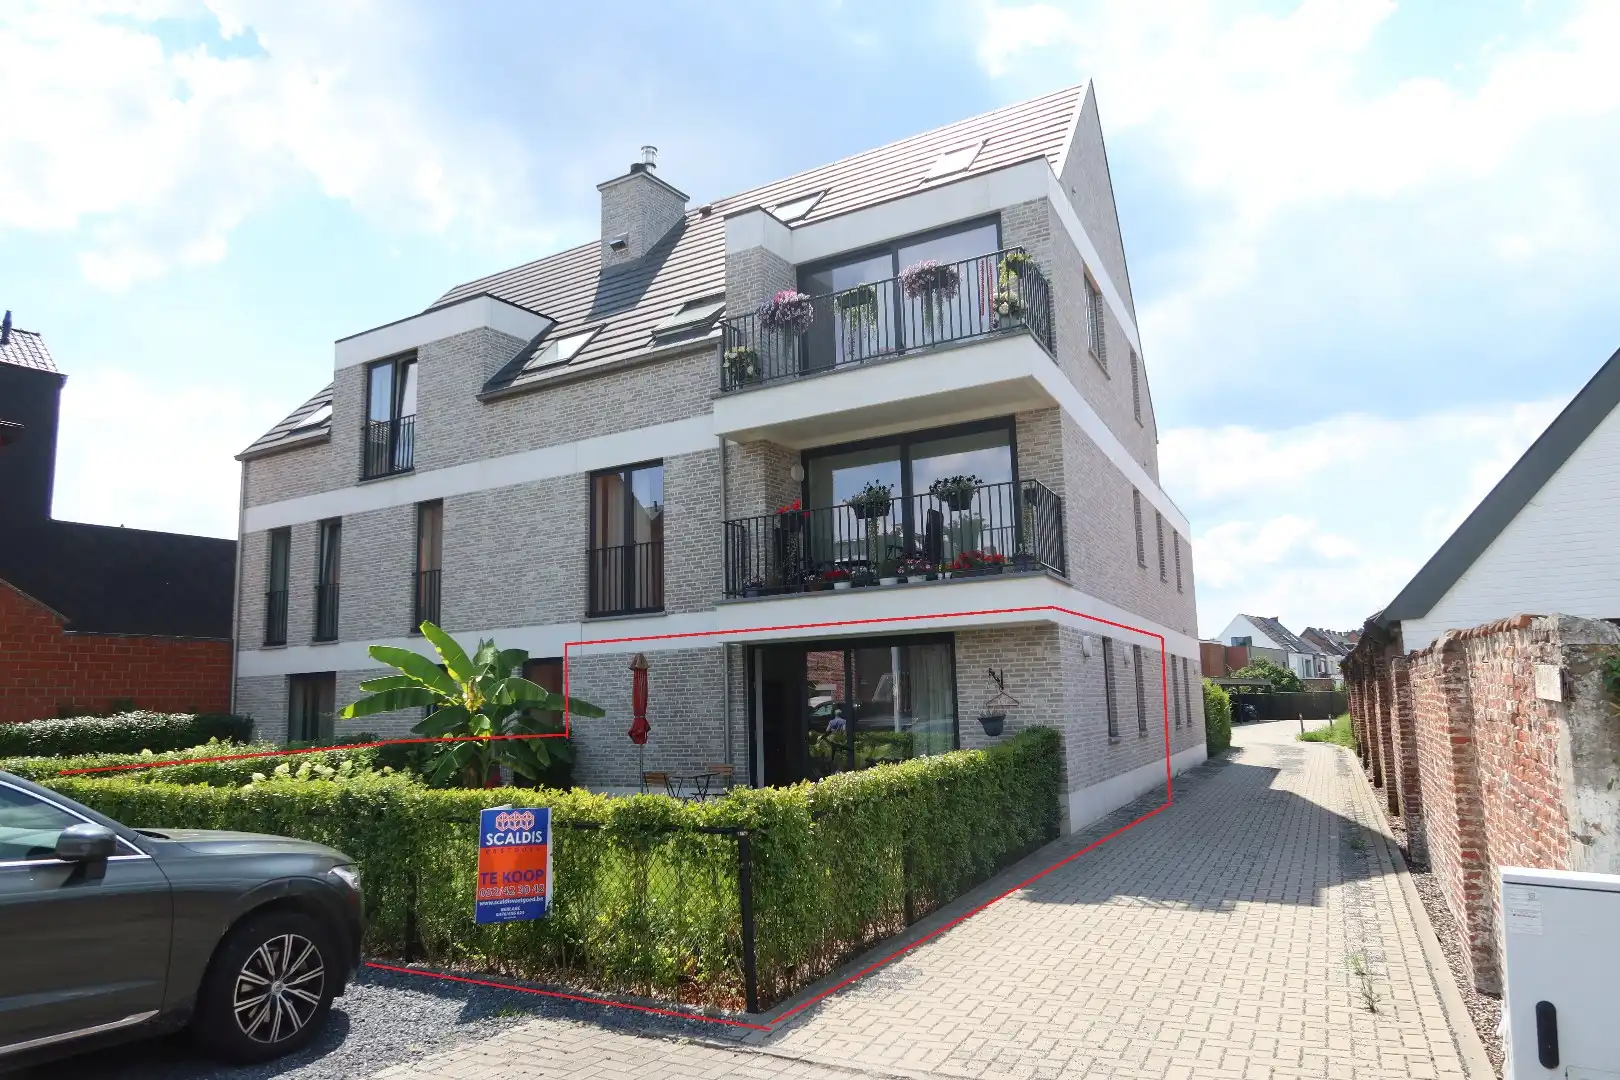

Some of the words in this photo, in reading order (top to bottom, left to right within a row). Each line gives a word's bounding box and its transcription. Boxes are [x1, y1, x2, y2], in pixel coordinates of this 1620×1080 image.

[486, 831, 543, 846] SCALDIS
[480, 872, 498, 885] TE
[503, 868, 545, 883] KOOP
